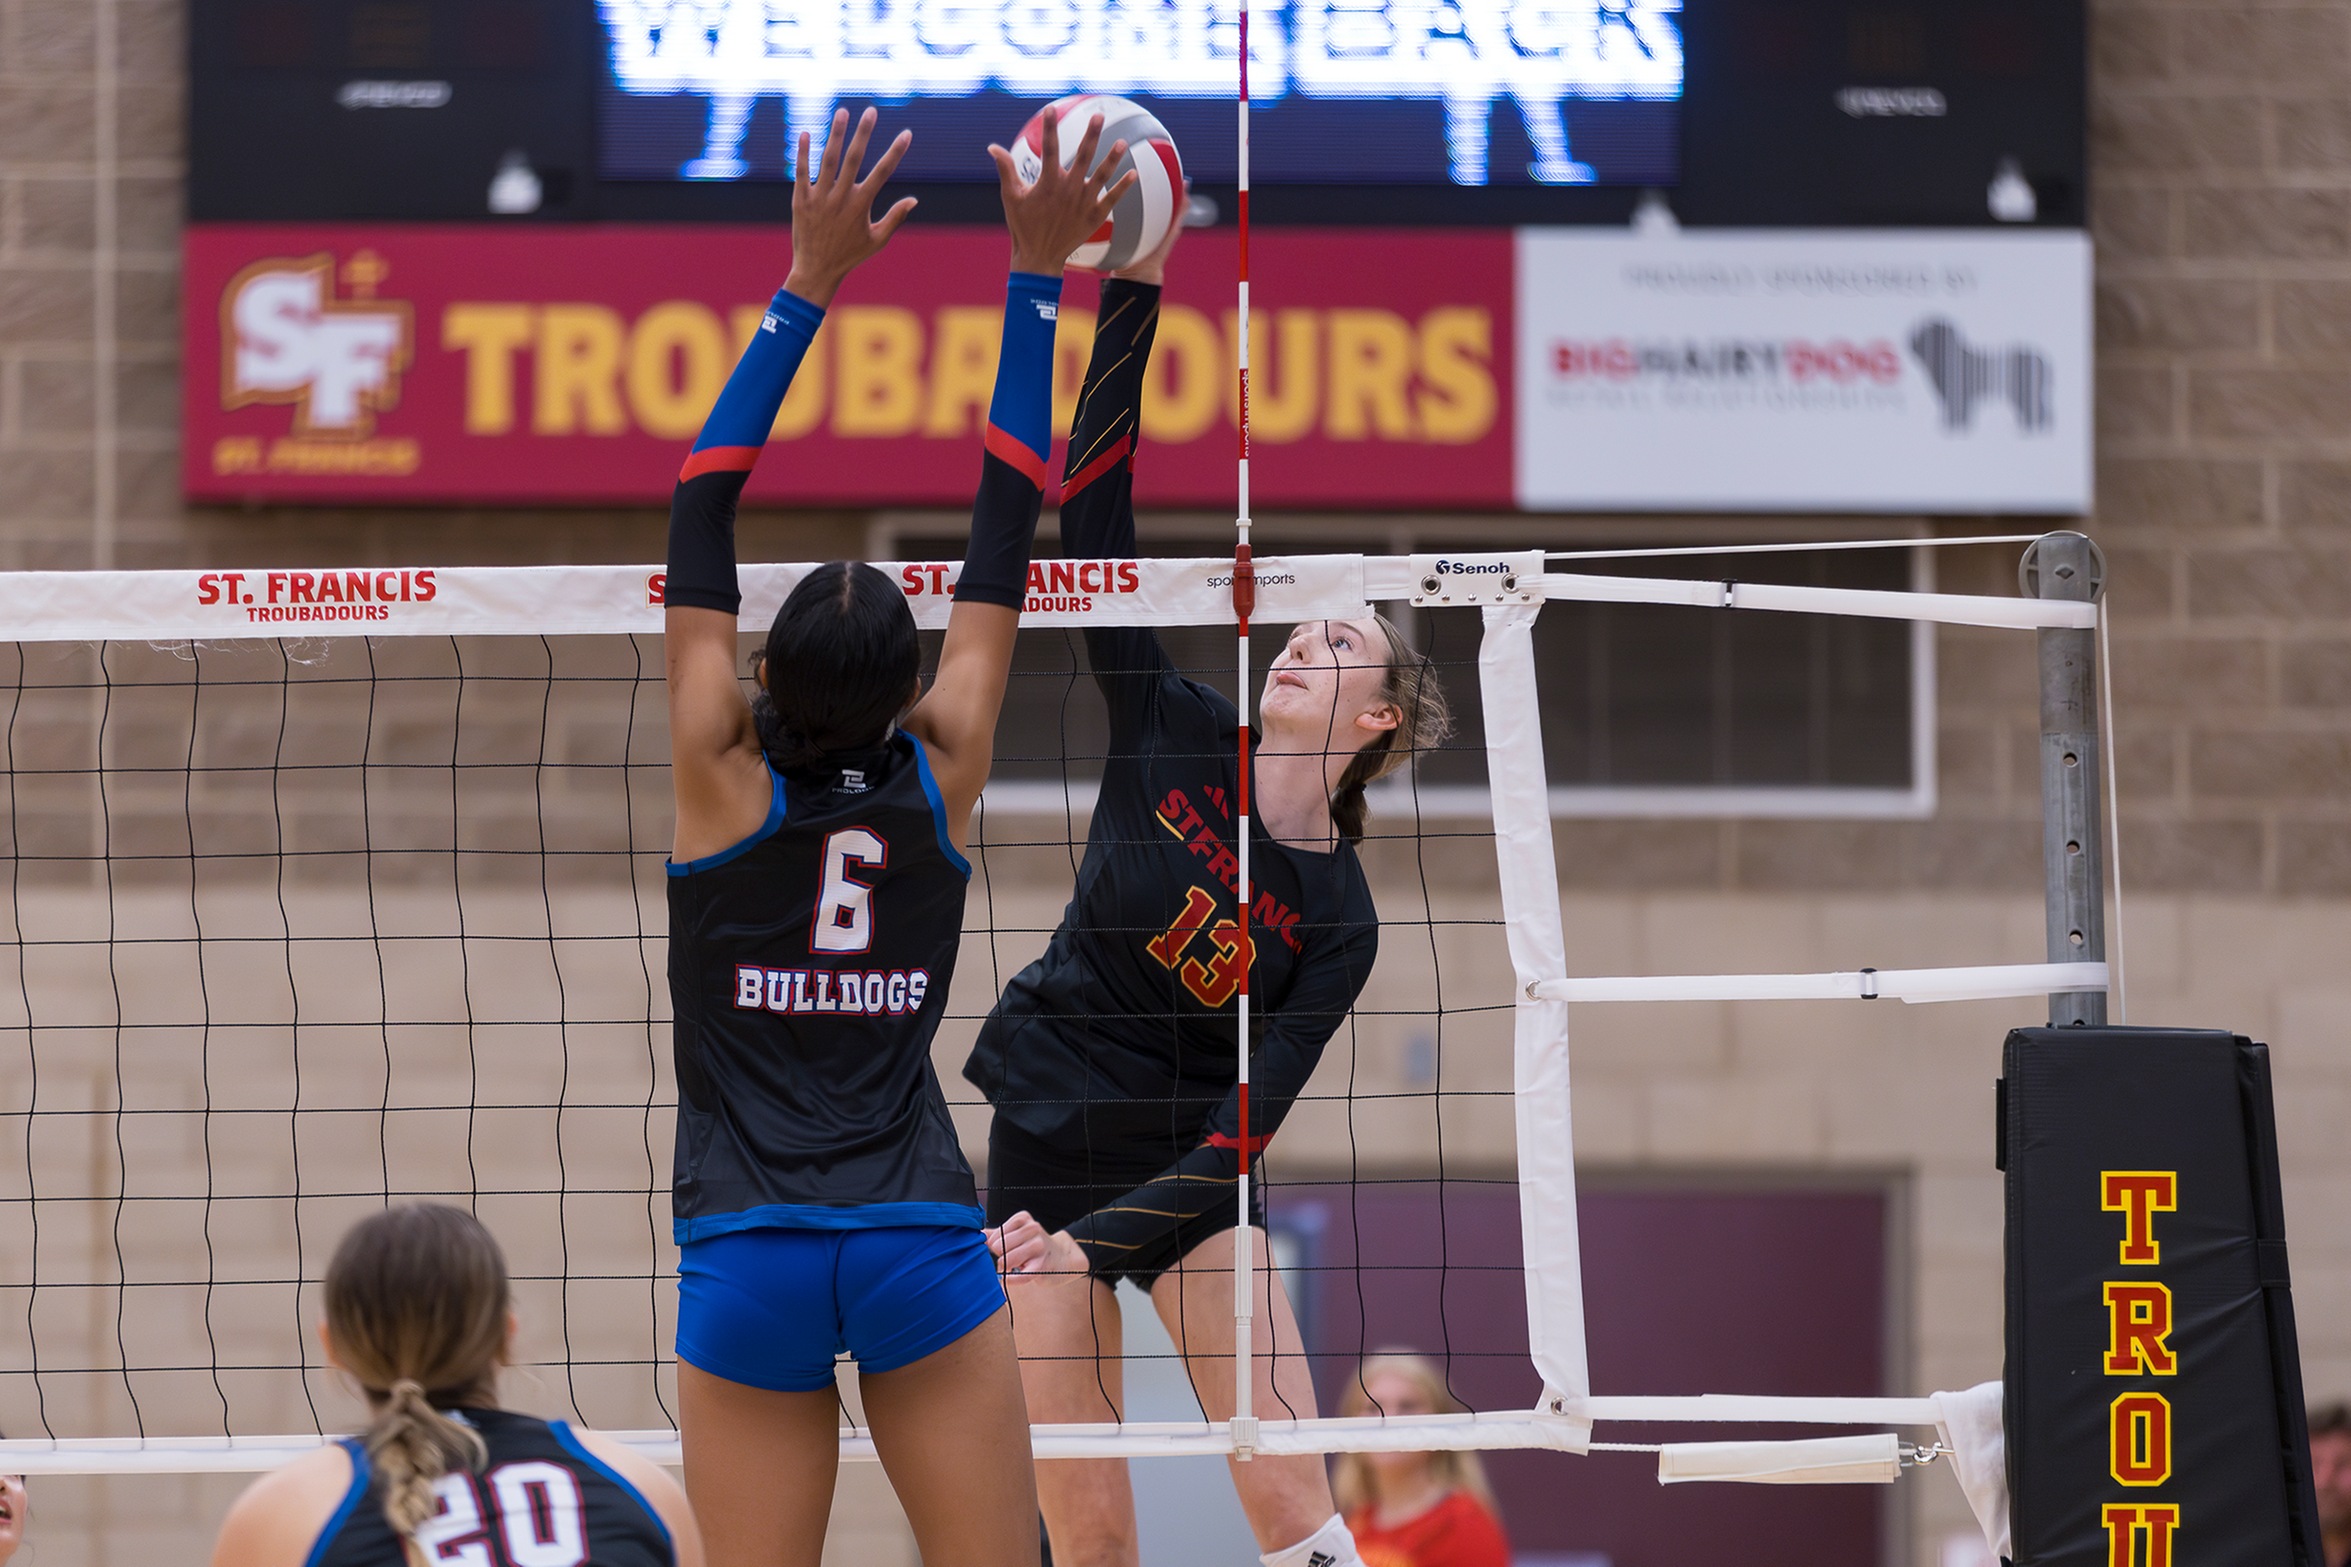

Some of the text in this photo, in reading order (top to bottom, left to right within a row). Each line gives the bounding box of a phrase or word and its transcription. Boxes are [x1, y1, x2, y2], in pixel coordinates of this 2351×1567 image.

[228, 266, 403, 432] SF
[198, 570, 437, 605] ST. FRANCIS
[1025, 561, 1140, 594] ANCIS
[1253, 574, 1296, 588] mports
[1452, 562, 1510, 575] Senoh
[247, 605, 389, 623] TROUBADOURS
[809, 825, 889, 955] 6
[1146, 885, 1257, 1008] 13
[734, 963, 931, 1016] BULLDOGS
[399, 1458, 591, 1567] 20
